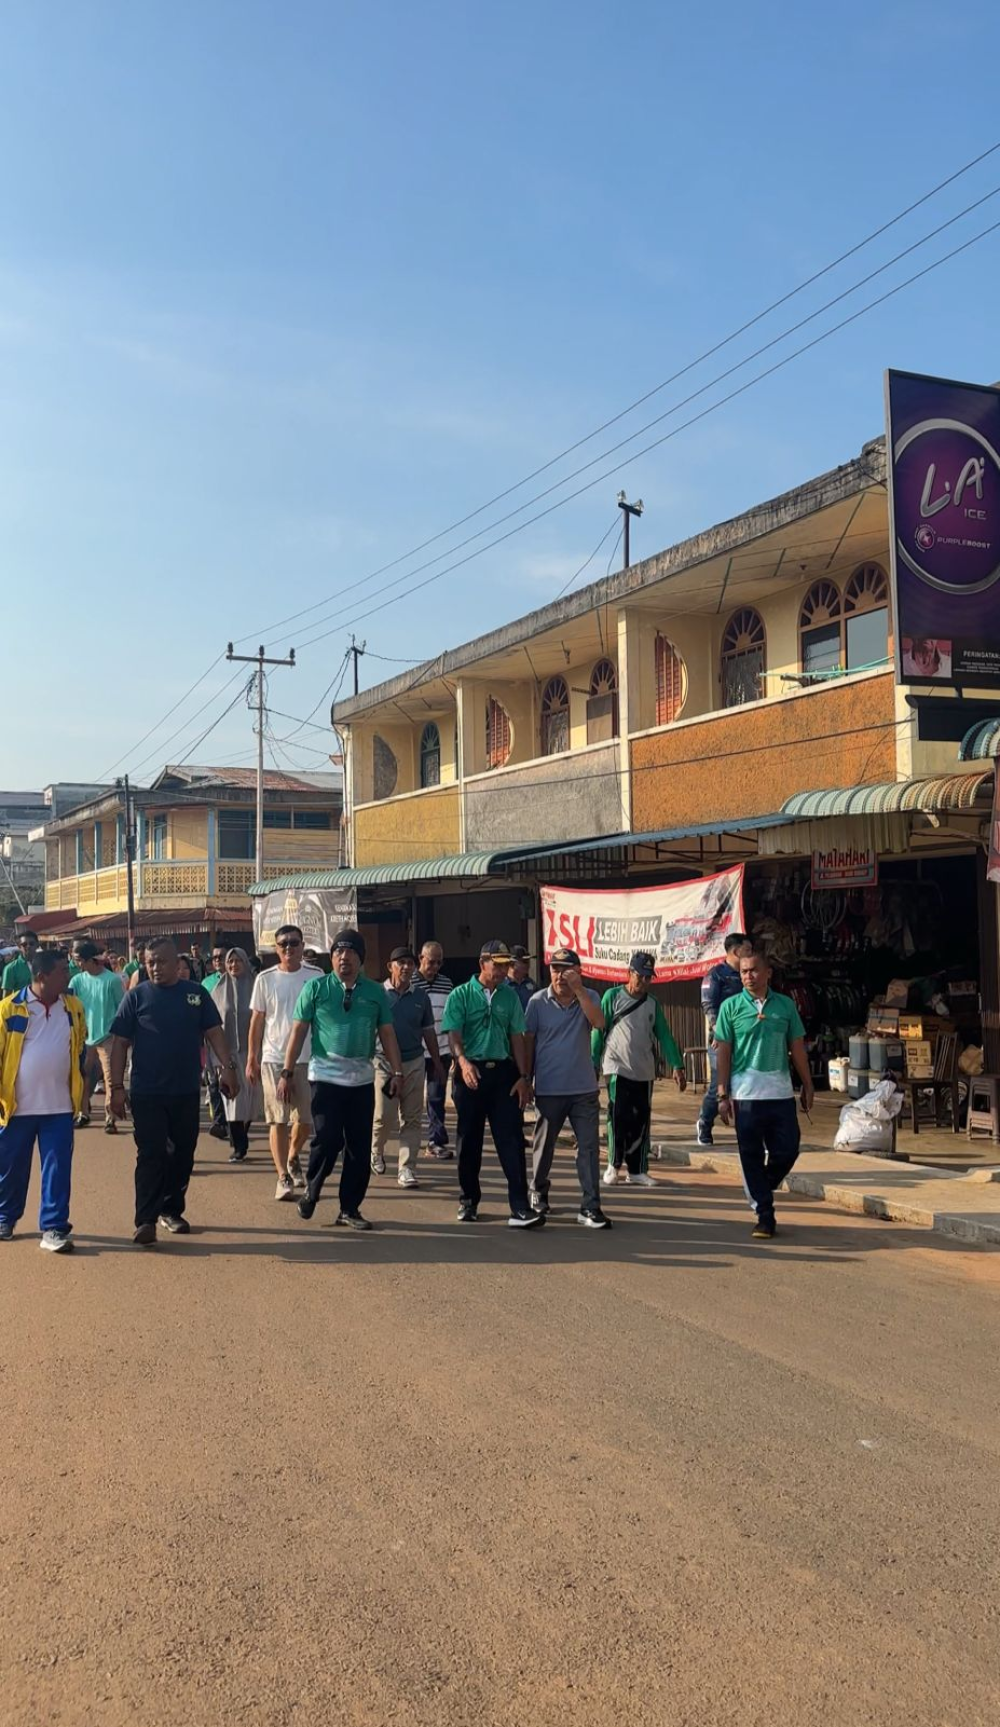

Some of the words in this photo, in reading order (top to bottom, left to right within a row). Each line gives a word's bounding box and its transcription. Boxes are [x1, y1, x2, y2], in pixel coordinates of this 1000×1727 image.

[964, 508, 987, 520] ICE
[598, 921, 628, 942] LEBIH
[631, 920, 658, 942] BAIK
[608, 948, 630, 964] Cadang
